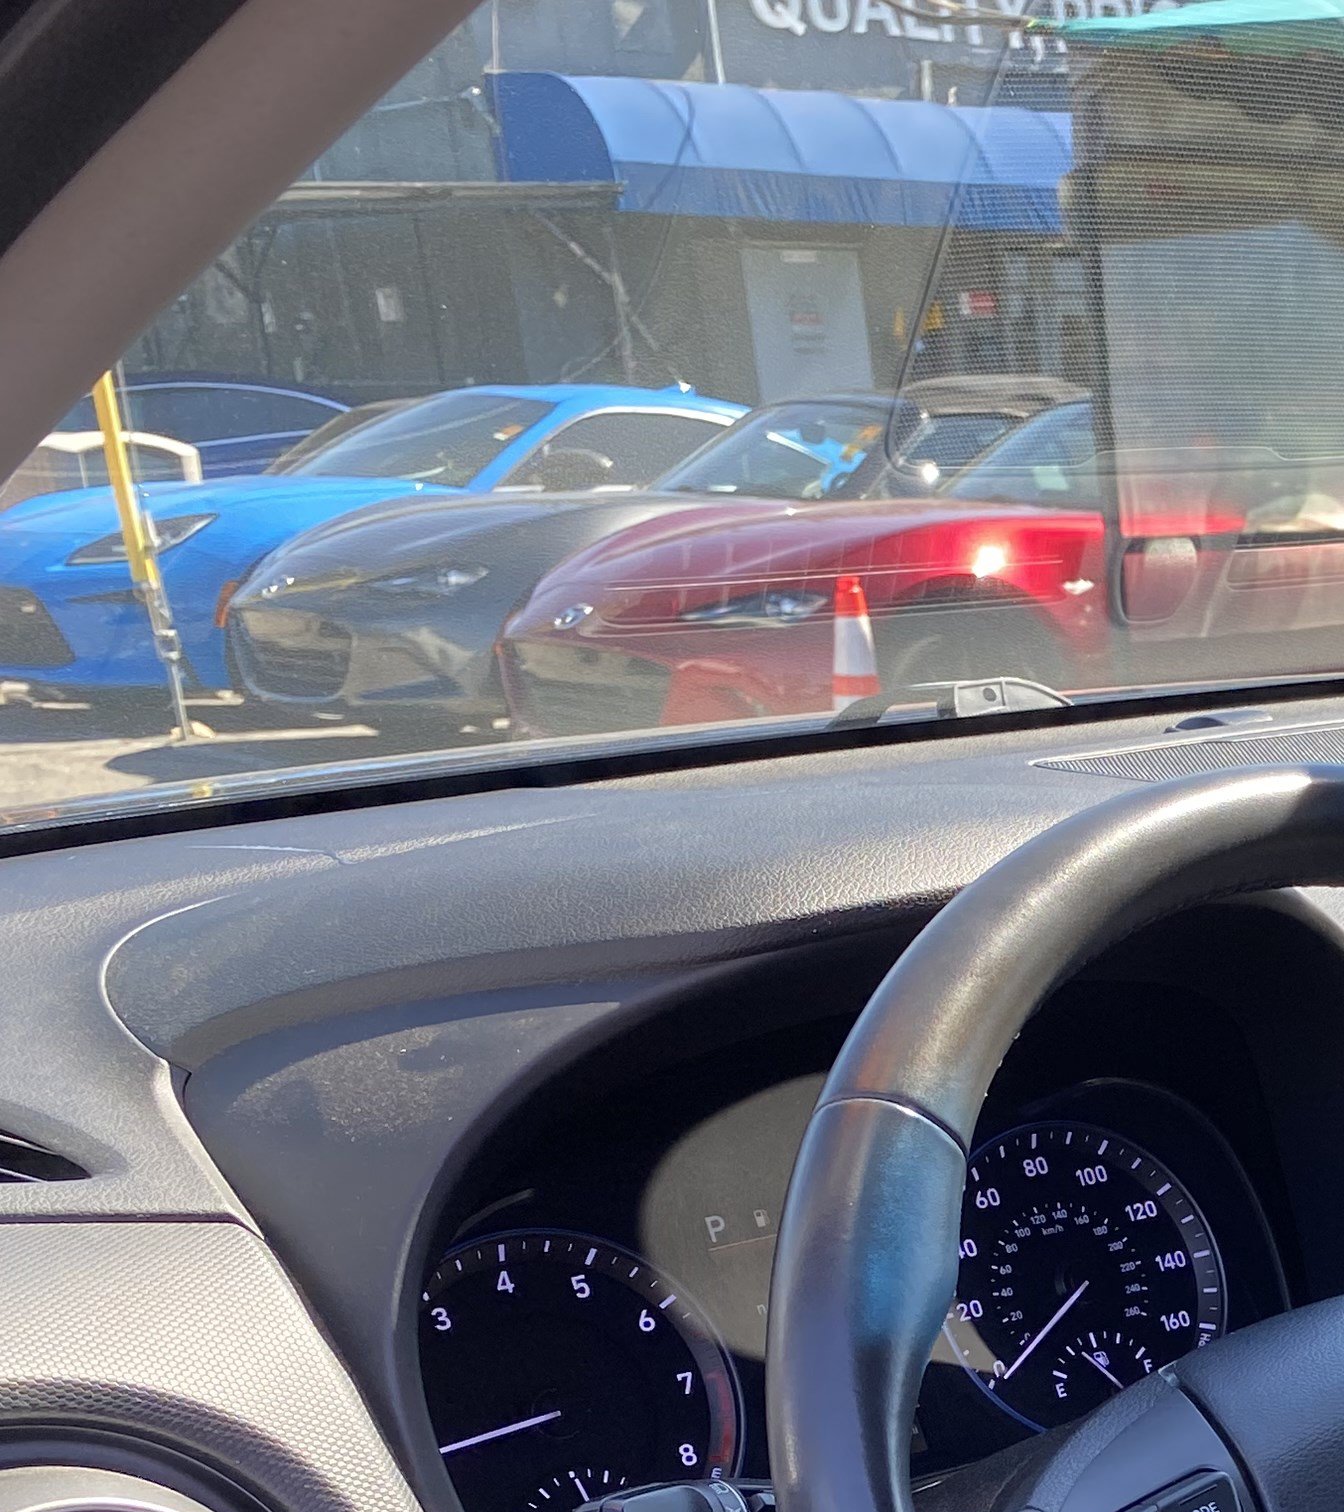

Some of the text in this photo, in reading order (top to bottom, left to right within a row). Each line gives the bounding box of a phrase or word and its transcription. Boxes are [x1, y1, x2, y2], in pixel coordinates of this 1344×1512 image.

[1022, 1156, 1049, 1178] 80
[1075, 1165, 1108, 1187] 100
[975, 1188, 1001, 1209] 60
[1030, 1214, 1047, 1225] 120
[1051, 1210, 1068, 1220] 140
[1074, 1215, 1090, 1226] 160
[1125, 1200, 1158, 1222] 120
[704, 1215, 726, 1243] P
[1014, 1227, 1031, 1238] 100
[1041, 1224, 1065, 1236] km/h
[1005, 1243, 1019, 1254] 80
[1000, 1264, 1013, 1275] 60
[1155, 1250, 1187, 1272] 140
[496, 1270, 515, 1294] 4
[570, 1274, 591, 1299] 5
[1000, 1287, 1013, 1297] 40
[431, 1307, 451, 1331] 3
[638, 1309, 656, 1332] 6
[956, 1299, 983, 1322] 20
[1010, 1311, 1023, 1321] 20
[1160, 1310, 1190, 1332] 160
[1143, 1358, 1153, 1373] F
[676, 1371, 693, 1395] 7
[1055, 1382, 1068, 1399] E
[679, 1443, 698, 1466] 8
